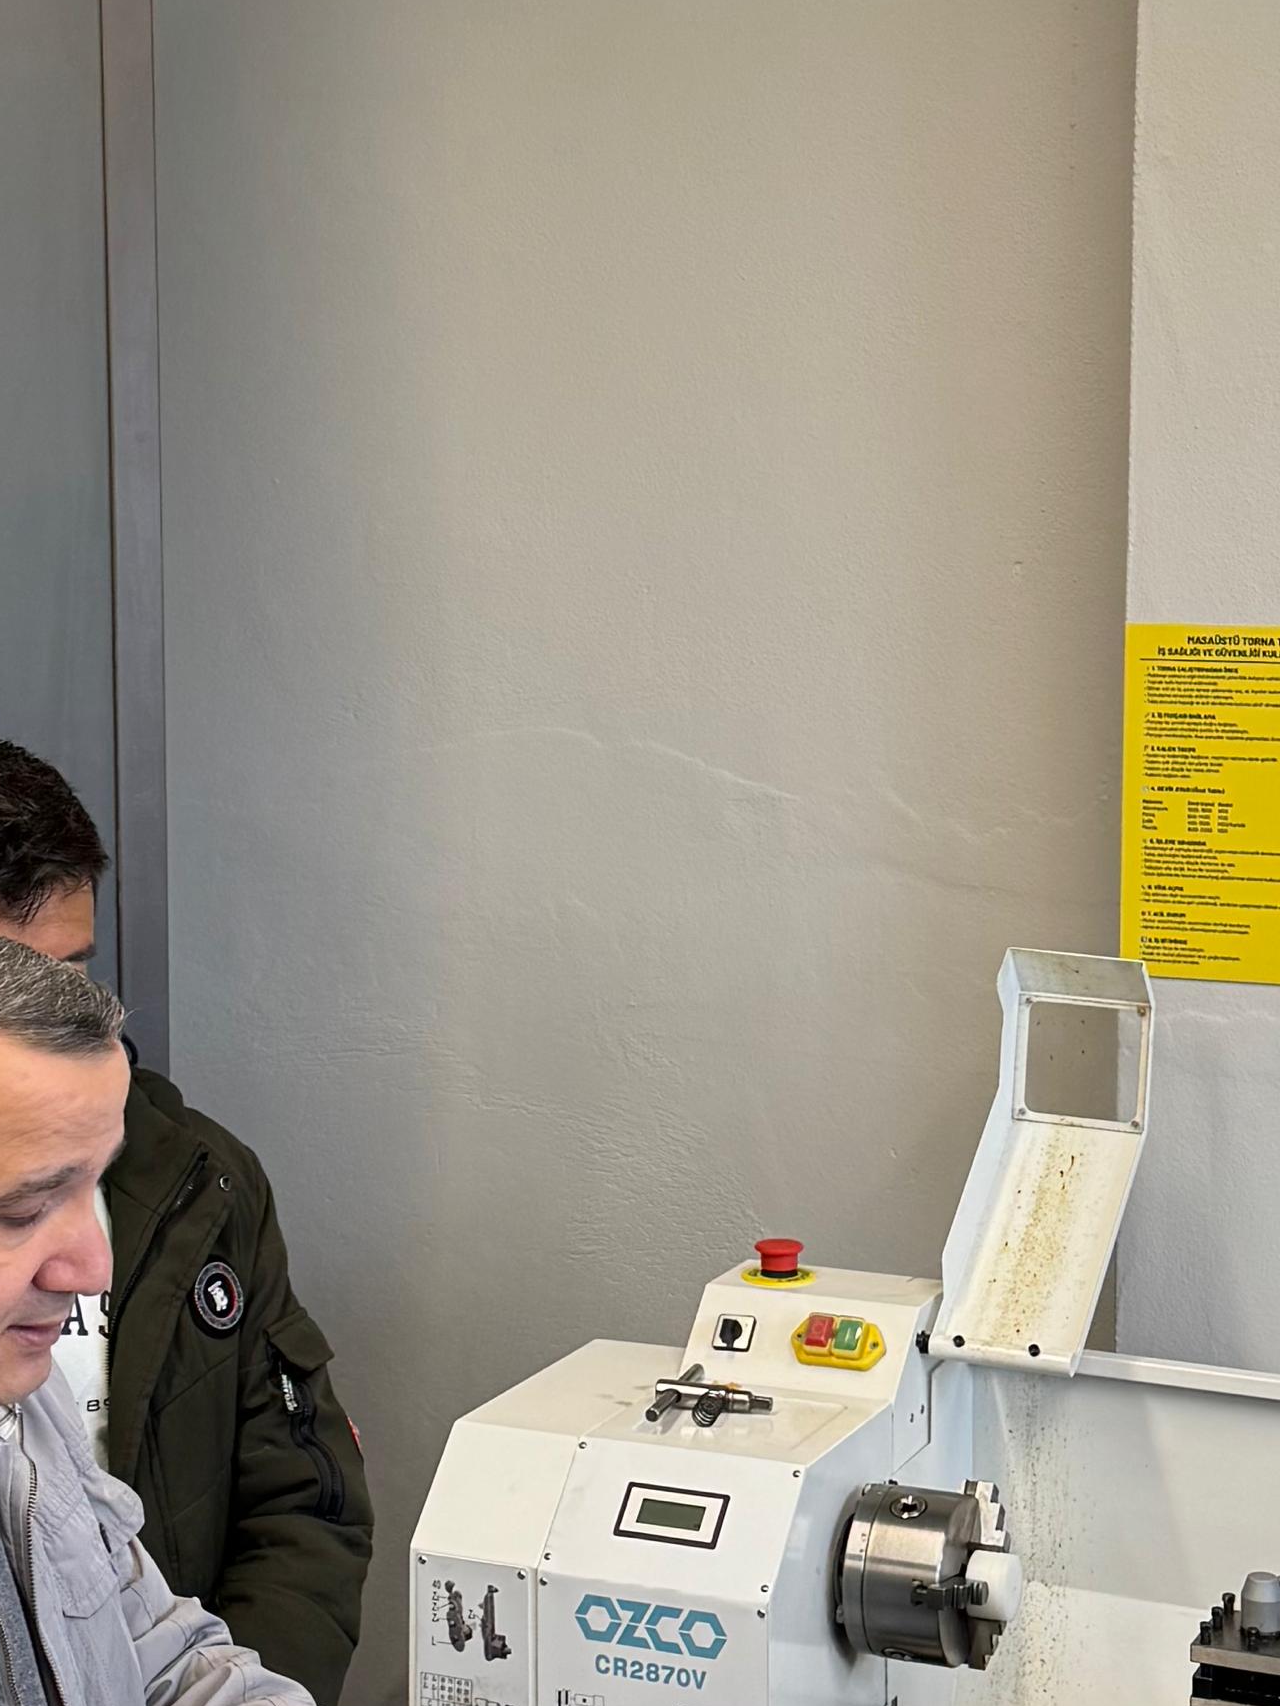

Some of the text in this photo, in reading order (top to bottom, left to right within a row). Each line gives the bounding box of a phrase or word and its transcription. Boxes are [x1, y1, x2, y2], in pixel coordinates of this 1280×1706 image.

[1202, 648, 1214, 657] VE
[1242, 636, 1276, 647] TORNA
[575, 1594, 727, 1660] OZCO
[594, 1653, 708, 1690] CR2870V
